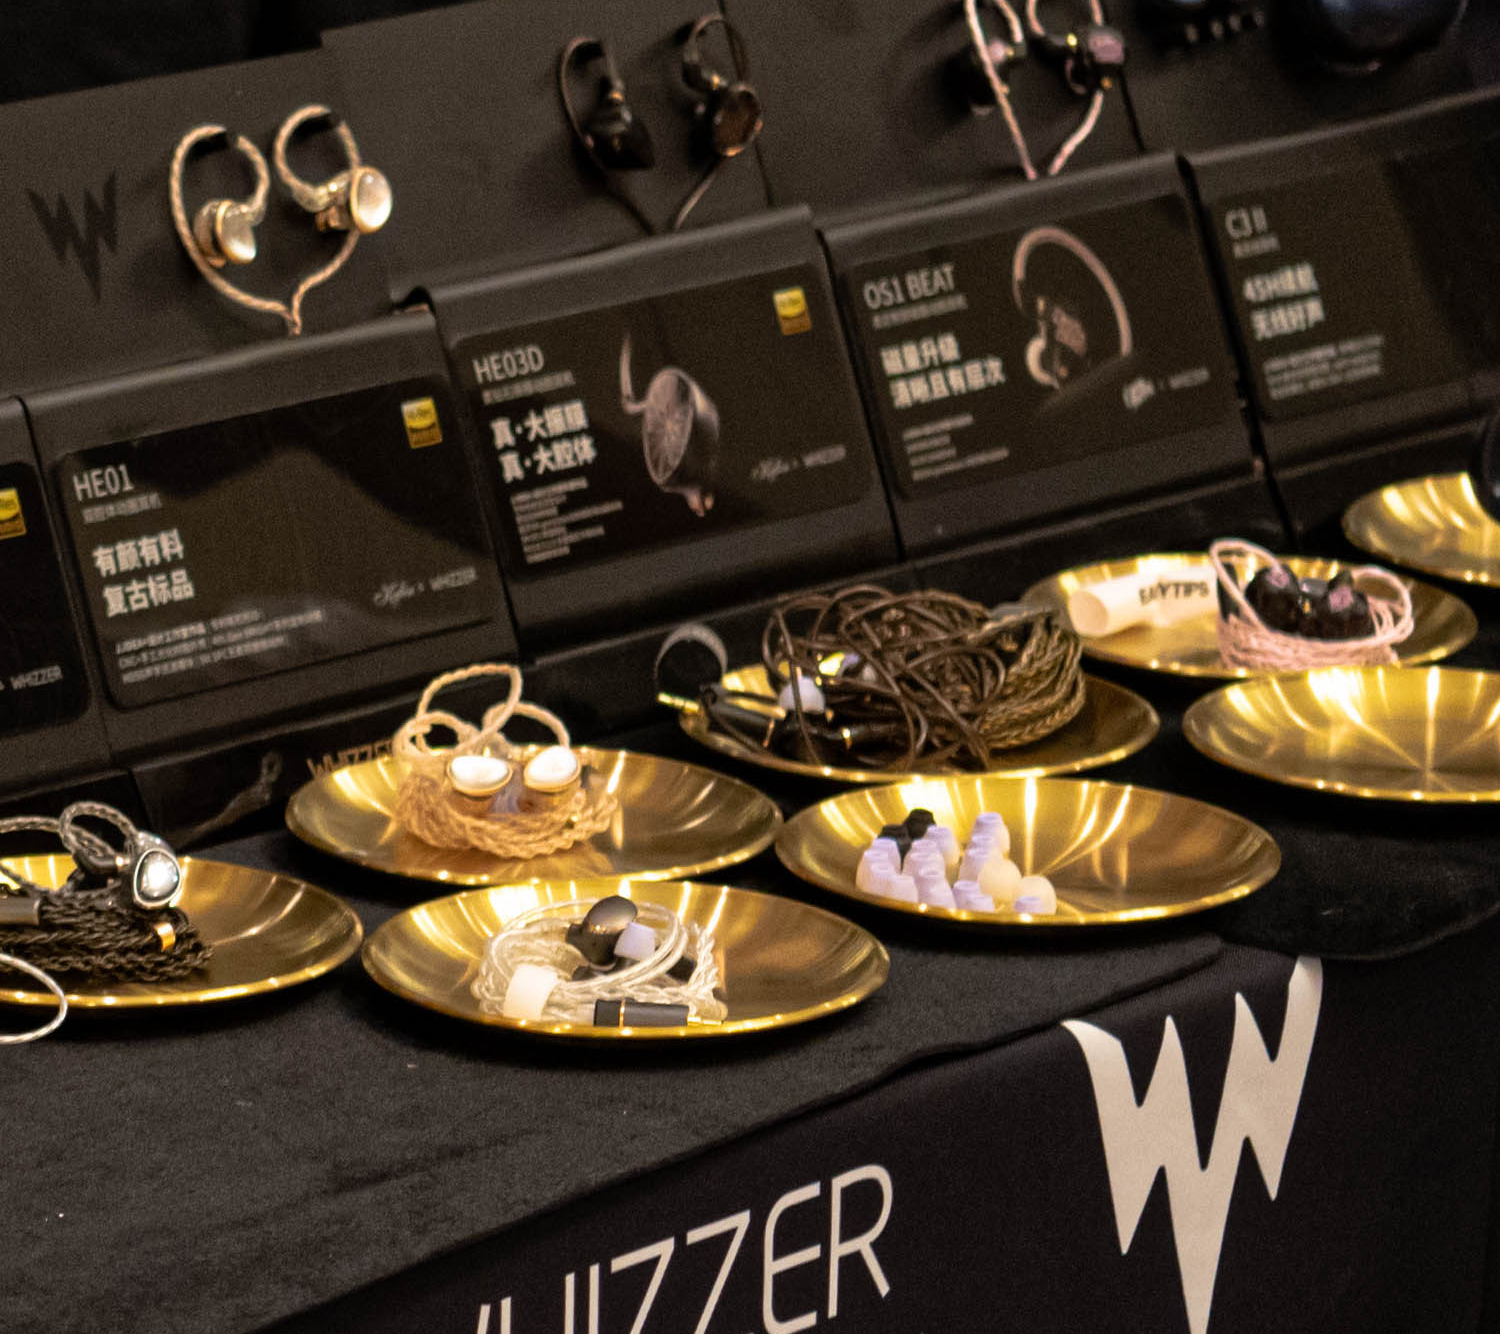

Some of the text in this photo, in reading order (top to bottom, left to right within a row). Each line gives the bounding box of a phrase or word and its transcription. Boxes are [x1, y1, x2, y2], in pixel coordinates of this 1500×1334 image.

[906, 263, 955, 292] BEAT
[473, 344, 545, 385] HE03D
[73, 464, 134, 502] HE01
[103, 569, 195, 617] 复古标品
[10, 665, 63, 691] WHIZZER
